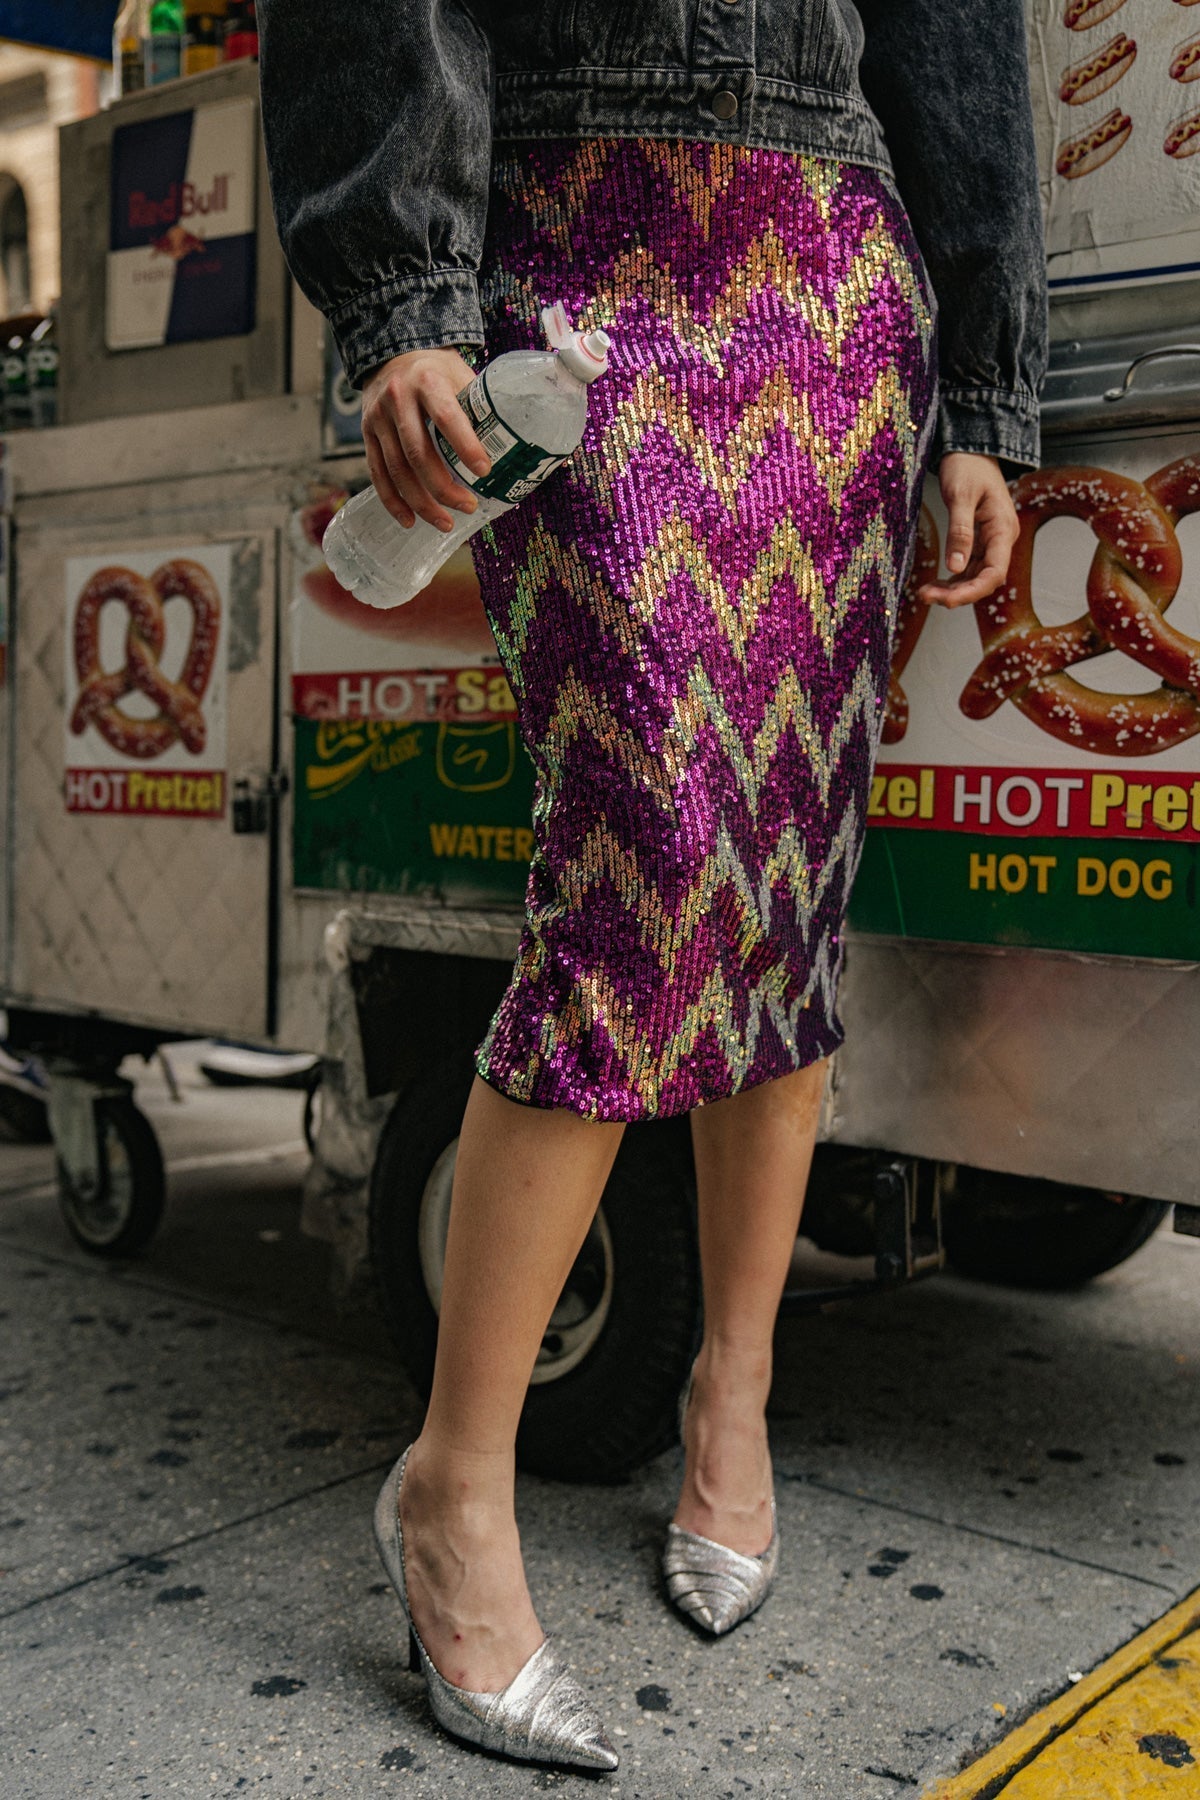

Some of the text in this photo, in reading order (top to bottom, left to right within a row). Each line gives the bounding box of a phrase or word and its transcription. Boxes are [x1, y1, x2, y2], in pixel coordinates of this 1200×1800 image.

[181, 175, 228, 217] Bull
[336, 674, 448, 717] HOT
[67, 772, 222, 812] HOT Pretzel
[953, 774, 1084, 828] HOT
[430, 823, 535, 862] WATER
[969, 853, 1173, 900] HOT DOG
